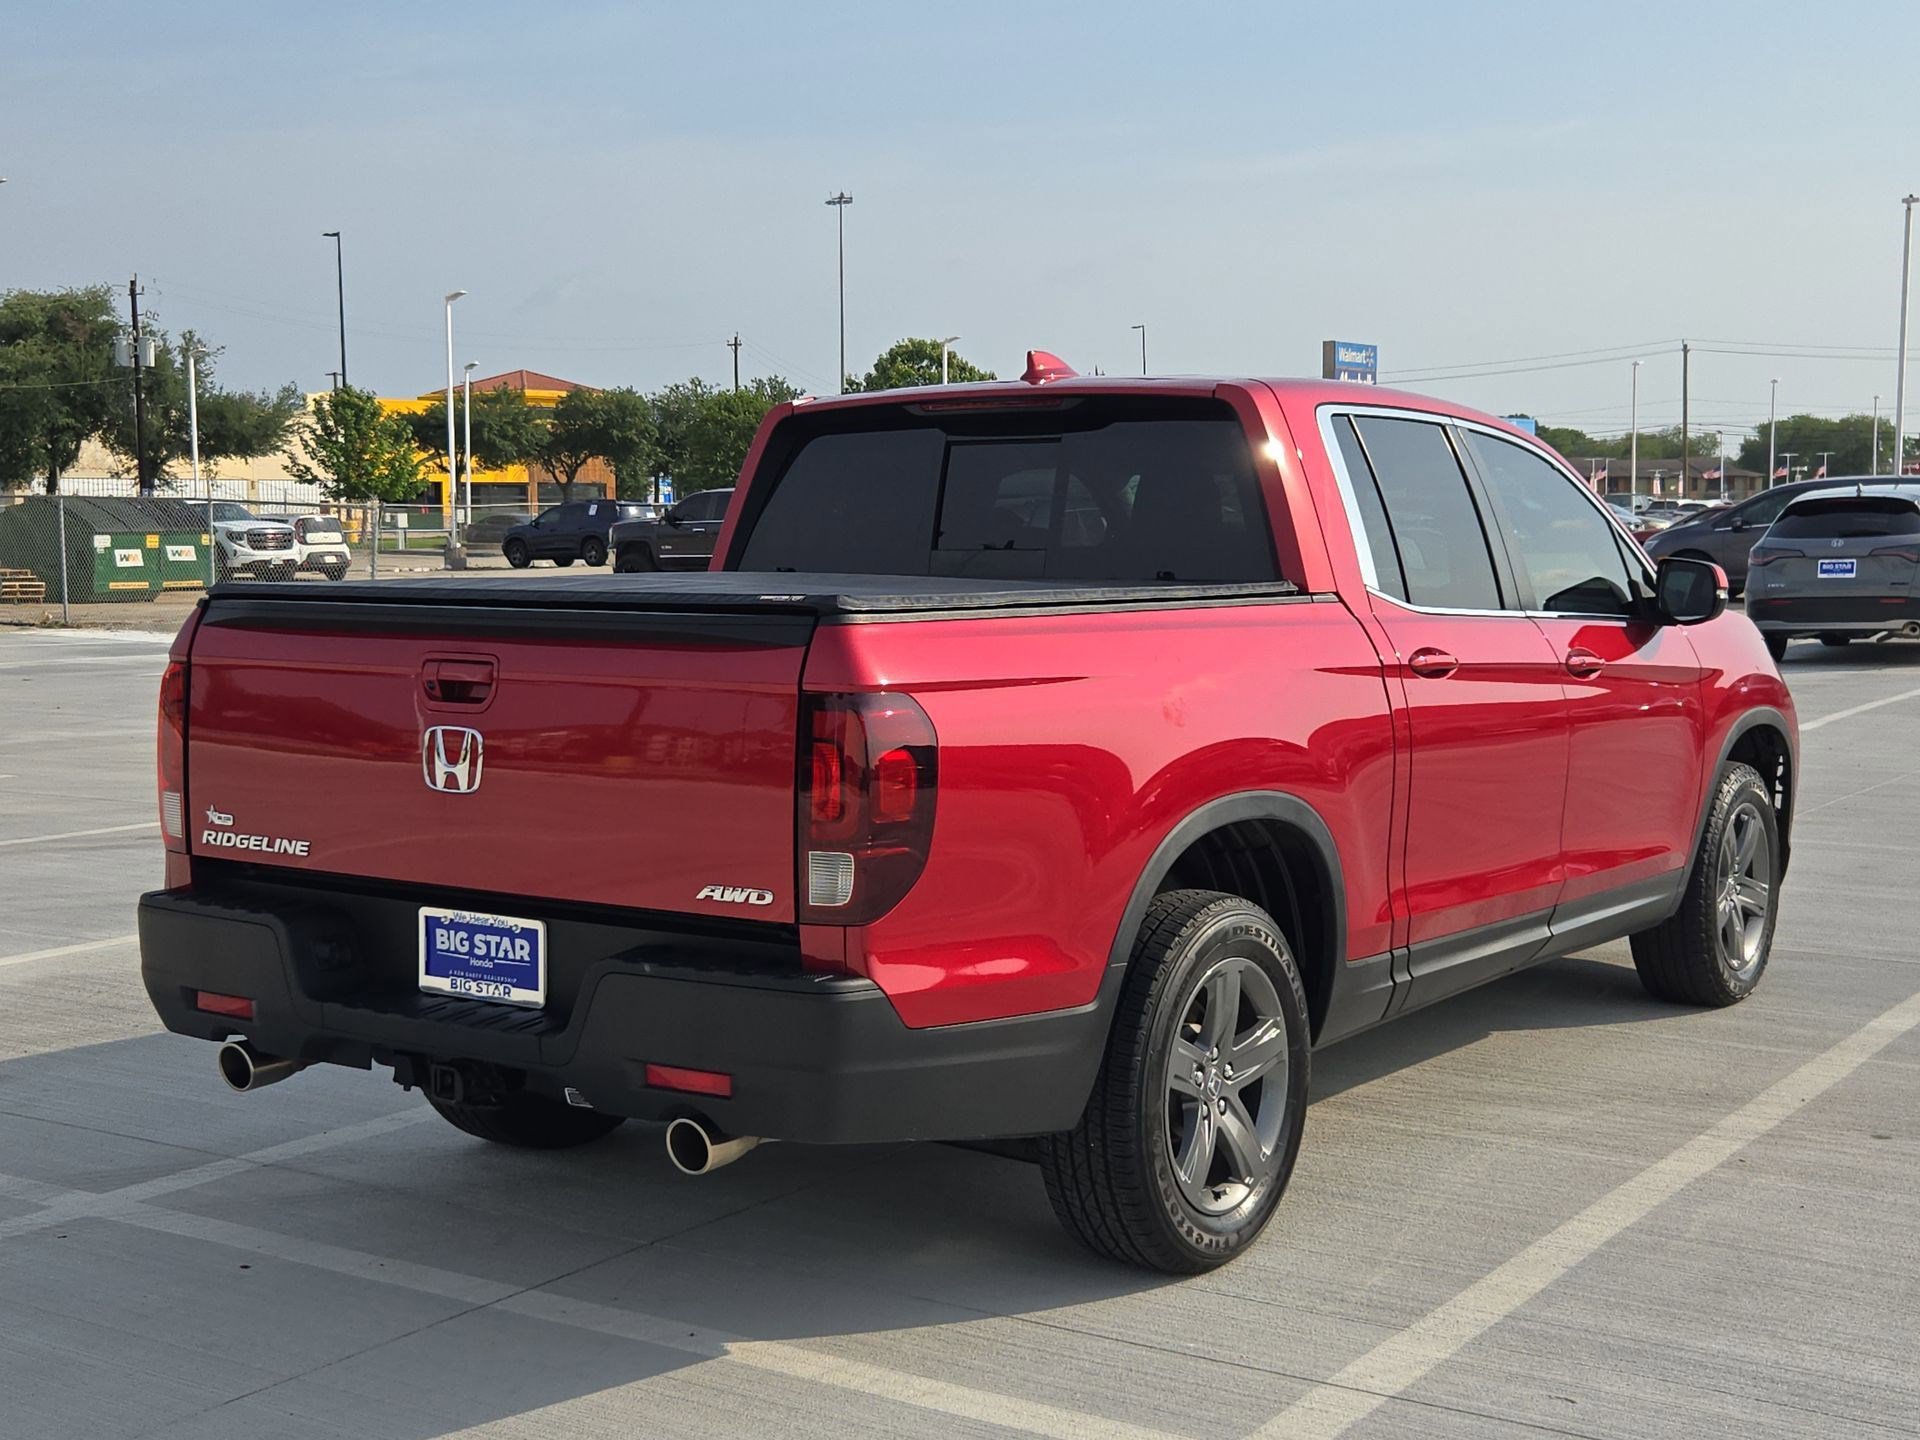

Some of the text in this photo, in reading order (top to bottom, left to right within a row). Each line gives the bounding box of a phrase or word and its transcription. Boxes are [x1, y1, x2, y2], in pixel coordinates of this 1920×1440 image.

[1338, 347, 1366, 364] Walmart
[202, 829, 311, 857] RIDGELINE
[696, 885, 774, 905] AWD
[453, 912, 509, 926] We Hear You
[435, 928, 531, 961] BIG STAR
[469, 957, 494, 968] Honda
[450, 978, 512, 997] BIG STAR
